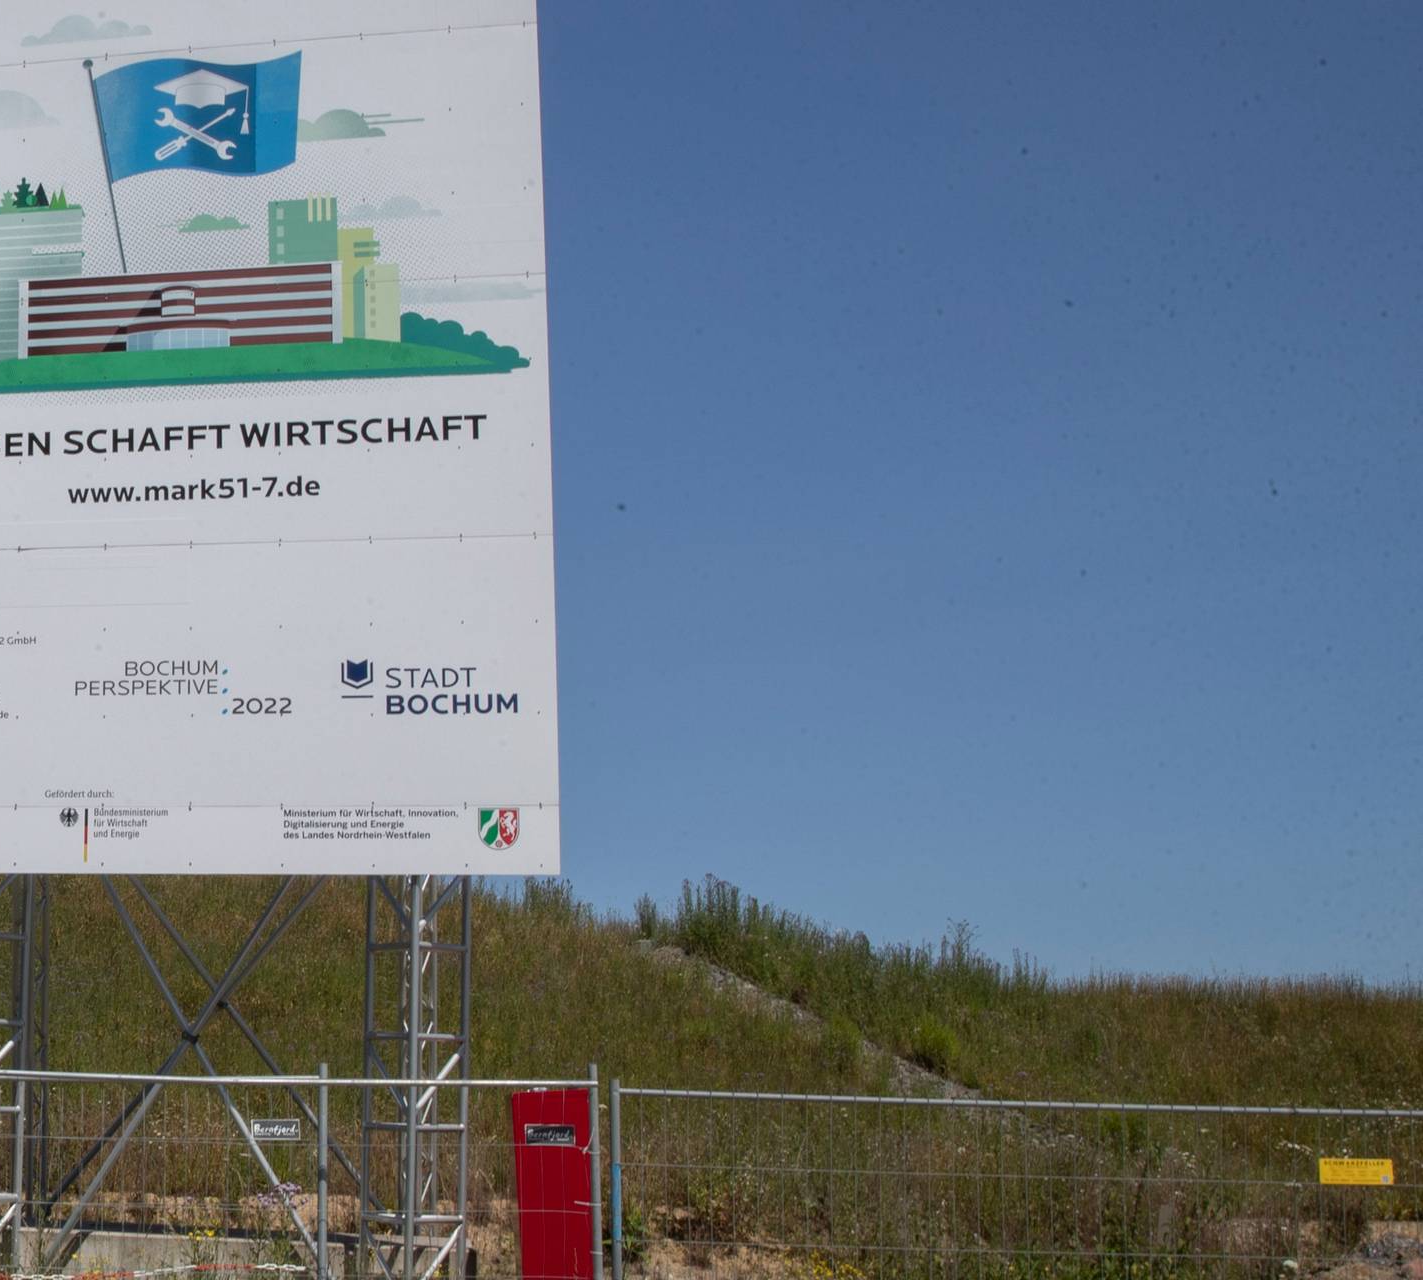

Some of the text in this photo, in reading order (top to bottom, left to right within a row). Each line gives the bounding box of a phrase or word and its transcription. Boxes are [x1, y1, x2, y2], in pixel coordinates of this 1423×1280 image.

[63, 424, 231, 455] SCHAFFT
[240, 414, 488, 448] WIRTSCHAFT
[67, 476, 321, 504] www.mark51-7.de
[7, 636, 37, 645] GmbH
[125, 660, 218, 677] BOCHUM
[385, 667, 477, 689] STADT
[74, 679, 218, 696] PERSPEKTIVE
[231, 697, 293, 715] 2022
[386, 693, 519, 715] BOCHUM
[44, 789, 115, 798] Gefördert durch:
[93, 808, 169, 817] Bundesministerium
[283, 808, 459, 818] Ministerium für Wirtschaft, Innovation,
[93, 819, 148, 828] für Wirtschaft
[283, 820, 405, 830] Digitalisierung und Energie
[93, 830, 140, 840] und Energie
[283, 831, 431, 840] des Landes Nordrhein-Westfalen
